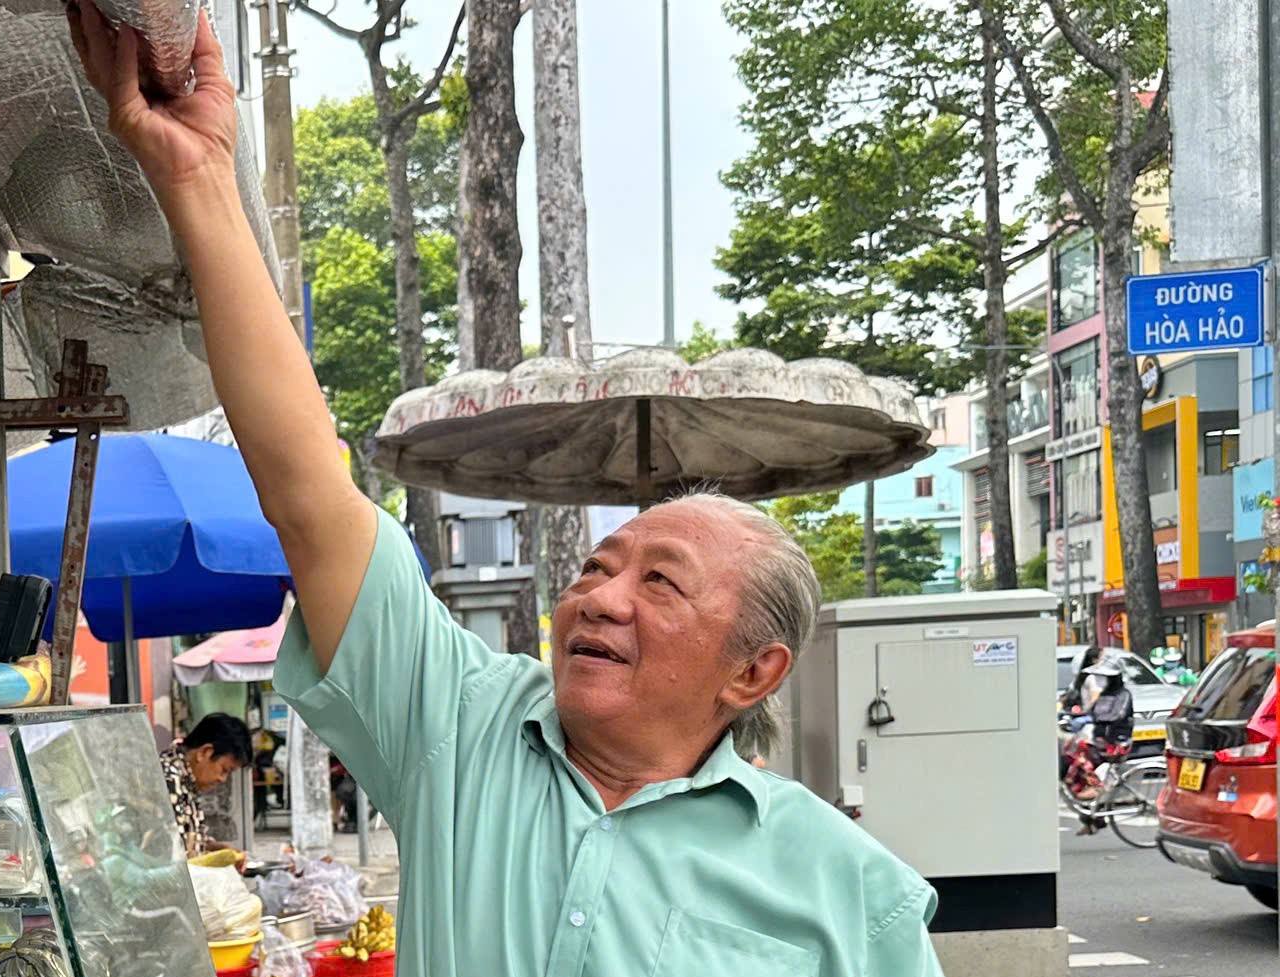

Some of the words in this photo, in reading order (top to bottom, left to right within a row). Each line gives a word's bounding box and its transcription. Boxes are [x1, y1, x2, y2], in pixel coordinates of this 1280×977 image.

[1155, 281, 1233, 306] ĐƯỜNG
[1145, 313, 1190, 345] HÒA
[1198, 307, 1244, 341] HẢO
